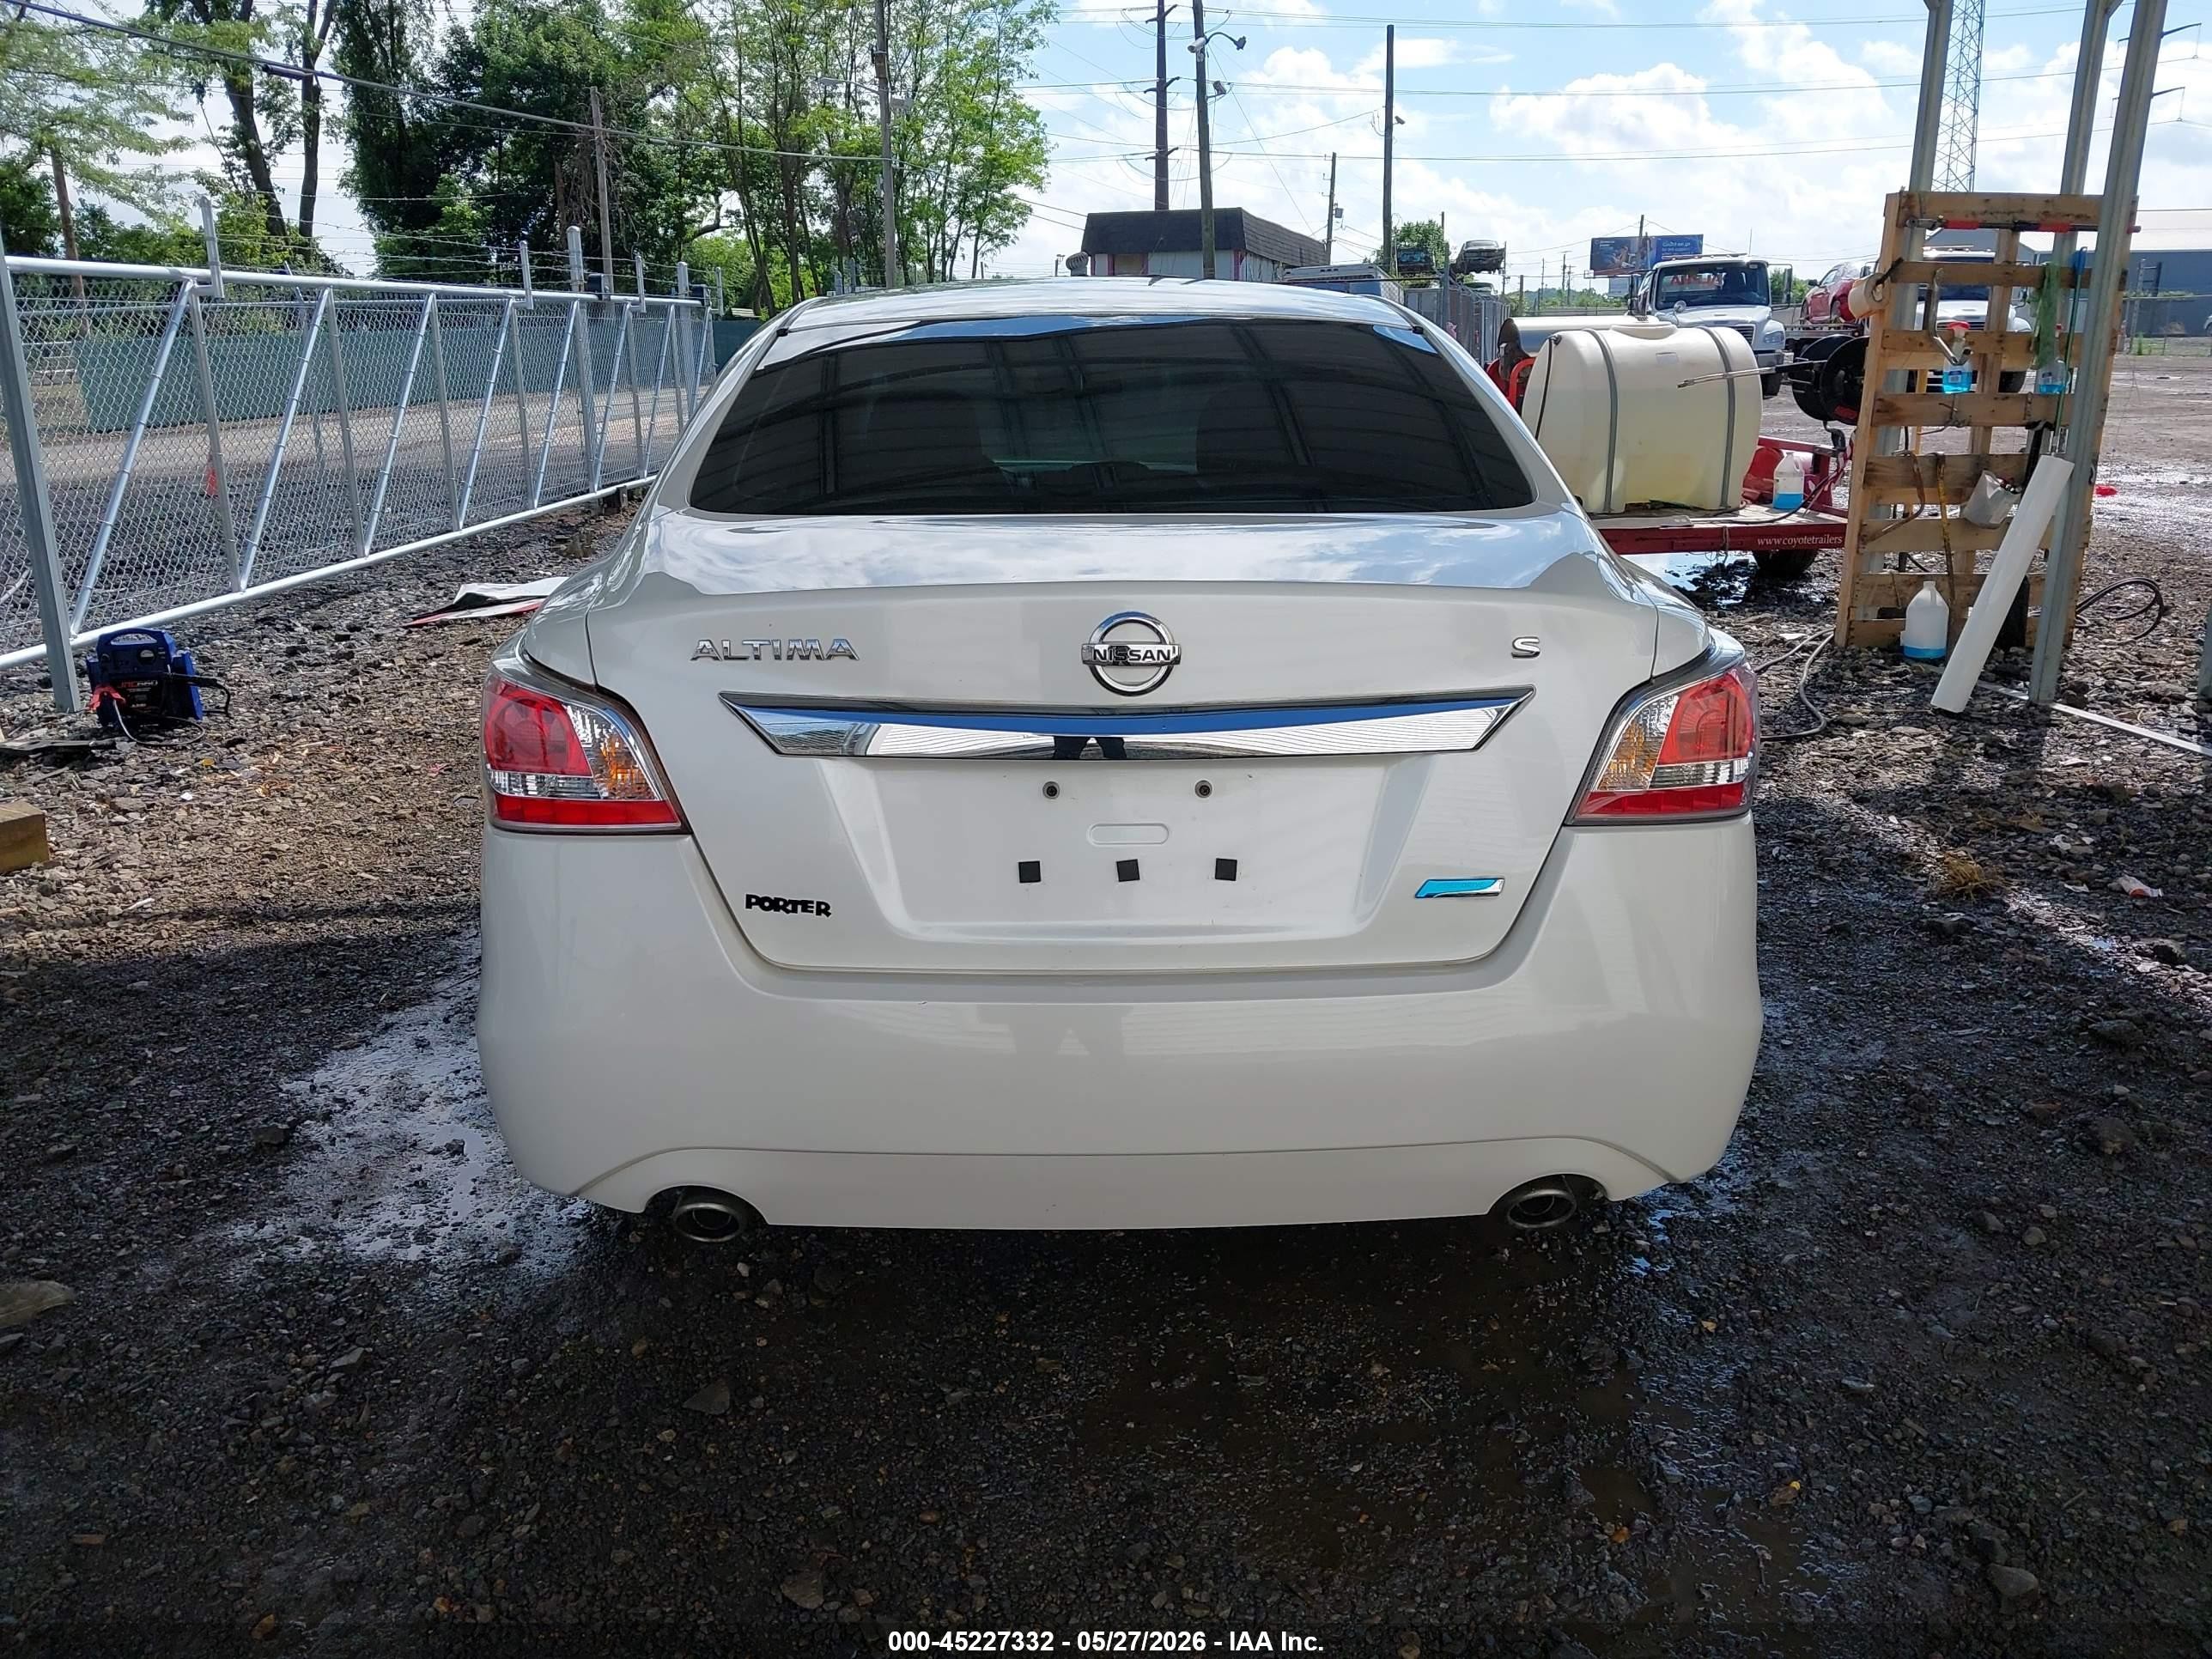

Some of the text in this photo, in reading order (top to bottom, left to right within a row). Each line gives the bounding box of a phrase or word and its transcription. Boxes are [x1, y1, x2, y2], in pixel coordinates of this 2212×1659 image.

[690, 639, 860, 661] ALTIMA
[1092, 648, 1171, 661] NISSAN
[1511, 635, 1541, 659] S
[745, 893, 832, 918] PORTER
